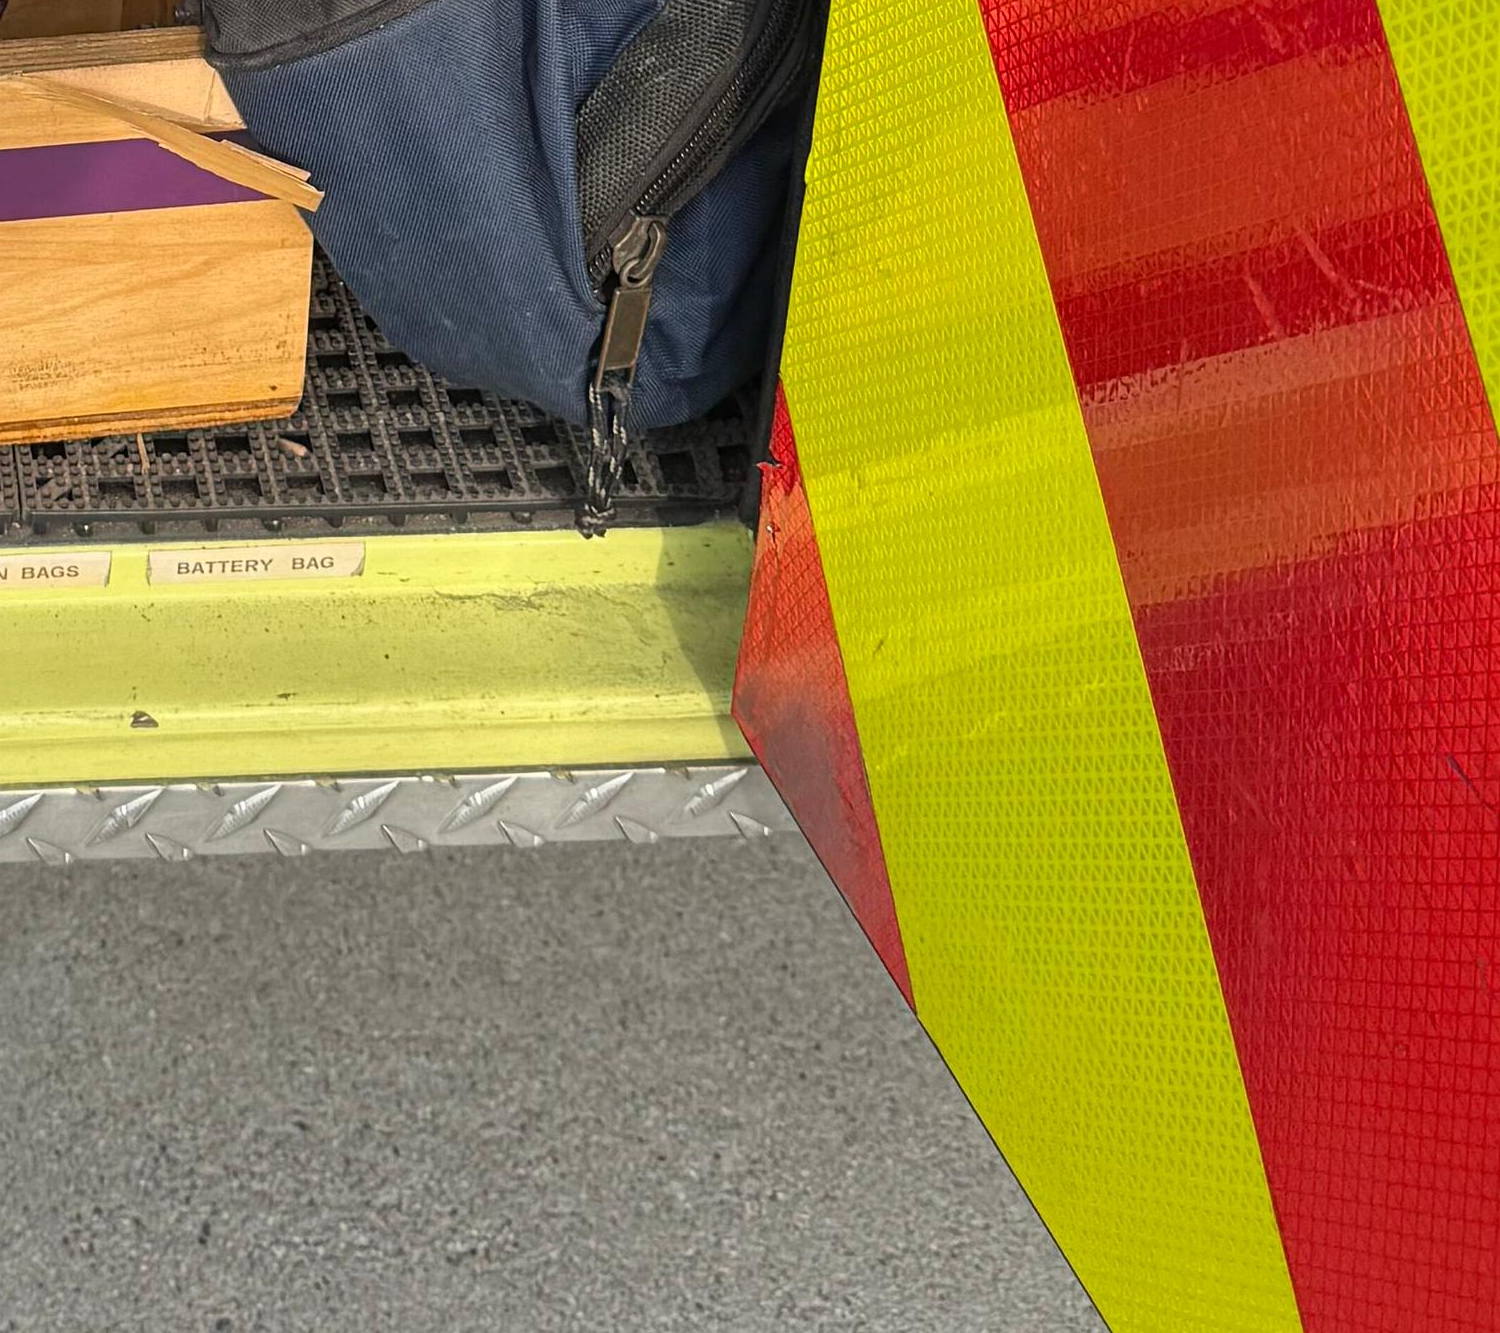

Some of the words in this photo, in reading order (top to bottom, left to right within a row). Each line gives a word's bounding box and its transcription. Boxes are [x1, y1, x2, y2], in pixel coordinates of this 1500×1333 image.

[21, 565, 80, 581] BAGS
[176, 558, 275, 575] BATTERY
[291, 556, 335, 571] BAG
